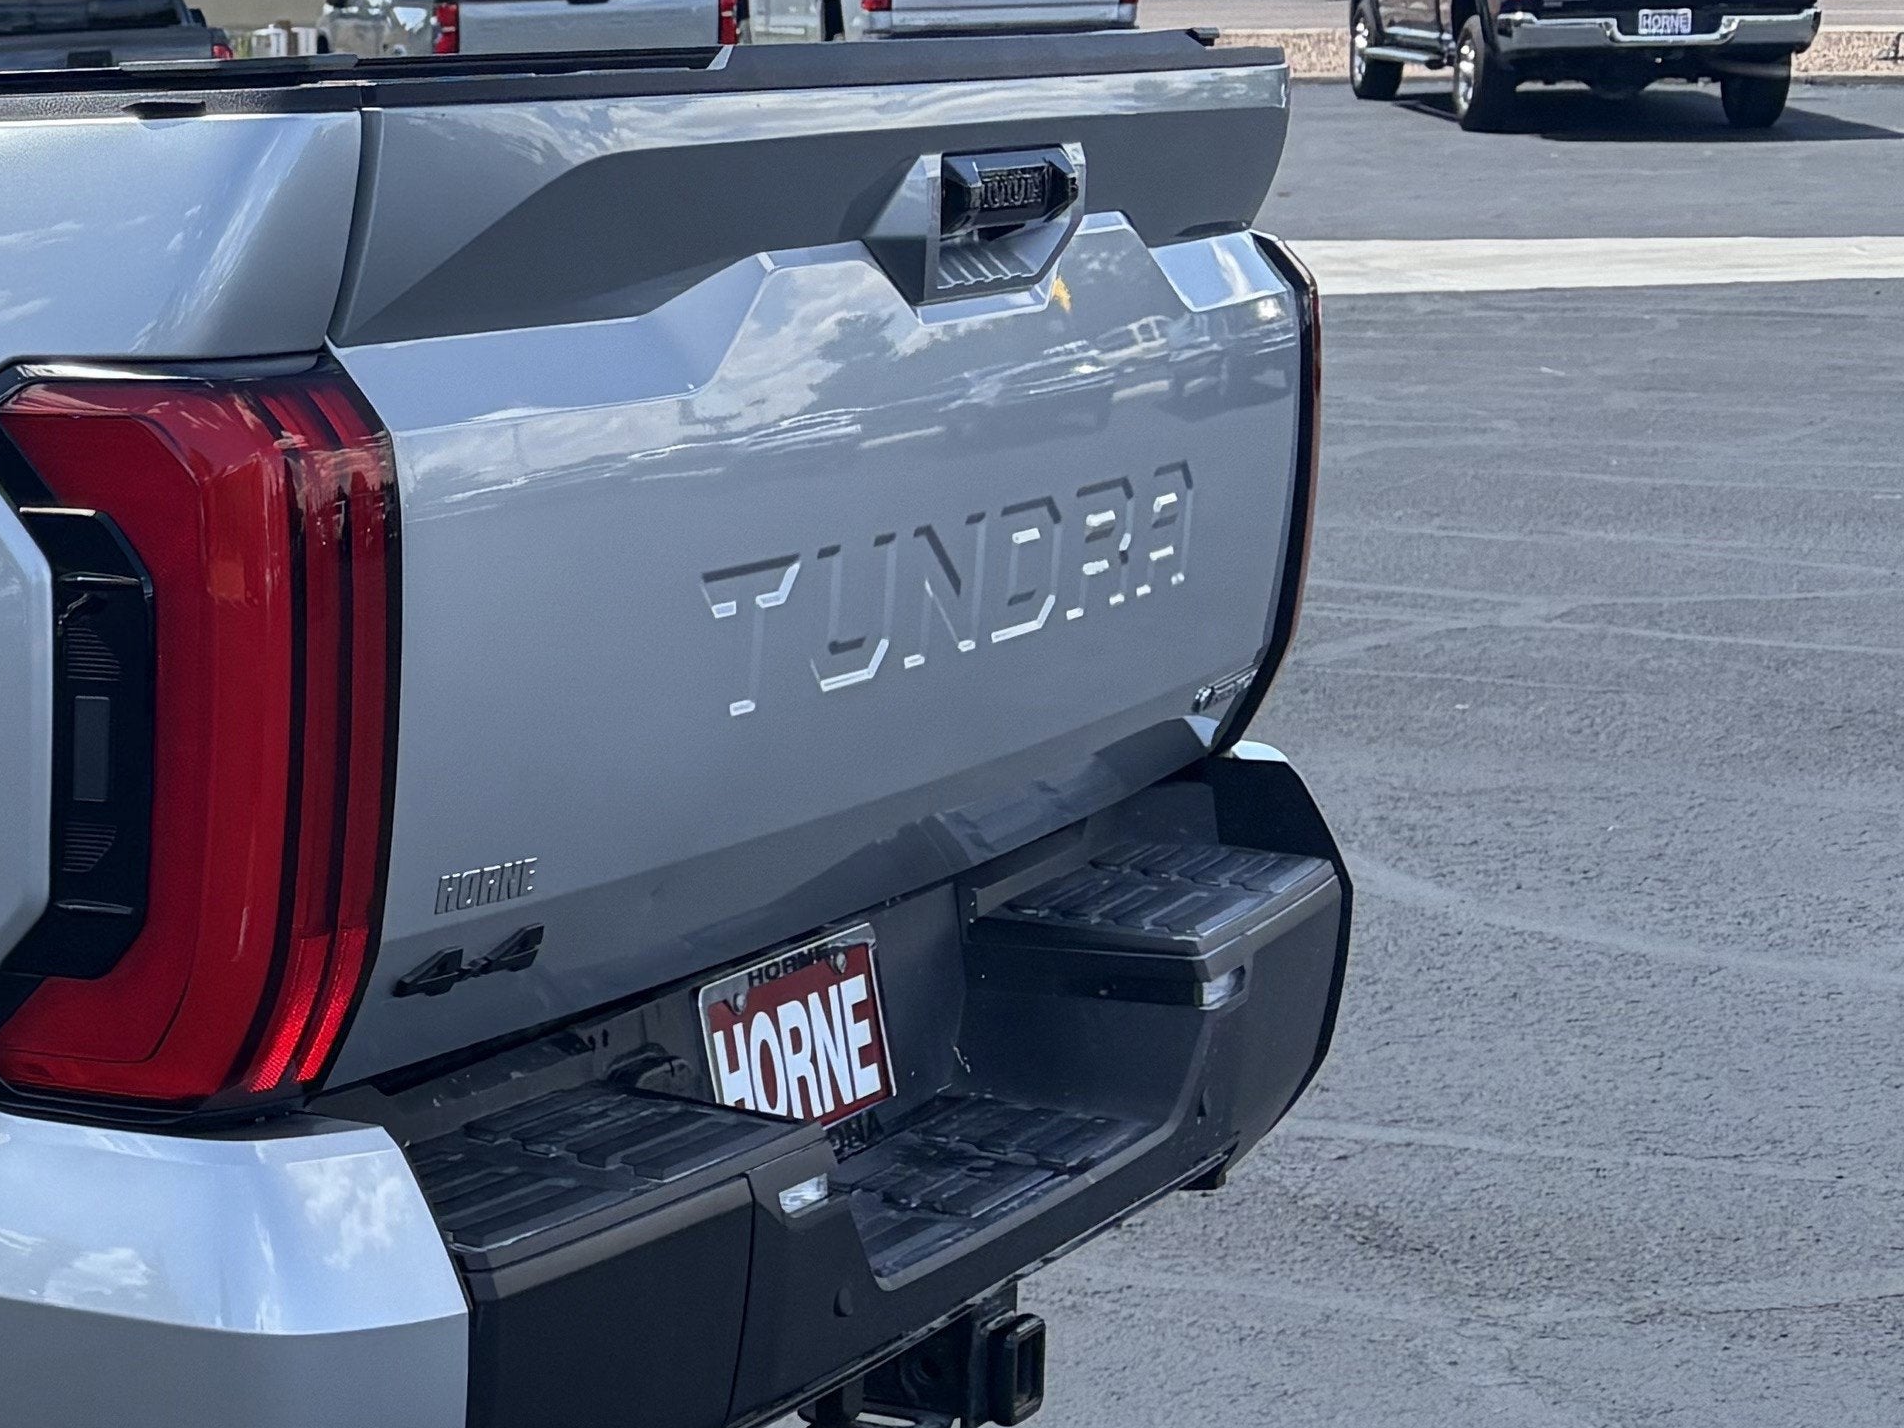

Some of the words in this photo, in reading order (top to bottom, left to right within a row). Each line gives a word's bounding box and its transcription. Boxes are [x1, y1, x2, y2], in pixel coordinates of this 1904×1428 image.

[701, 459, 1193, 716] TUNDRA
[434, 856, 538, 915] HORNE
[712, 973, 882, 1120] HORNE
